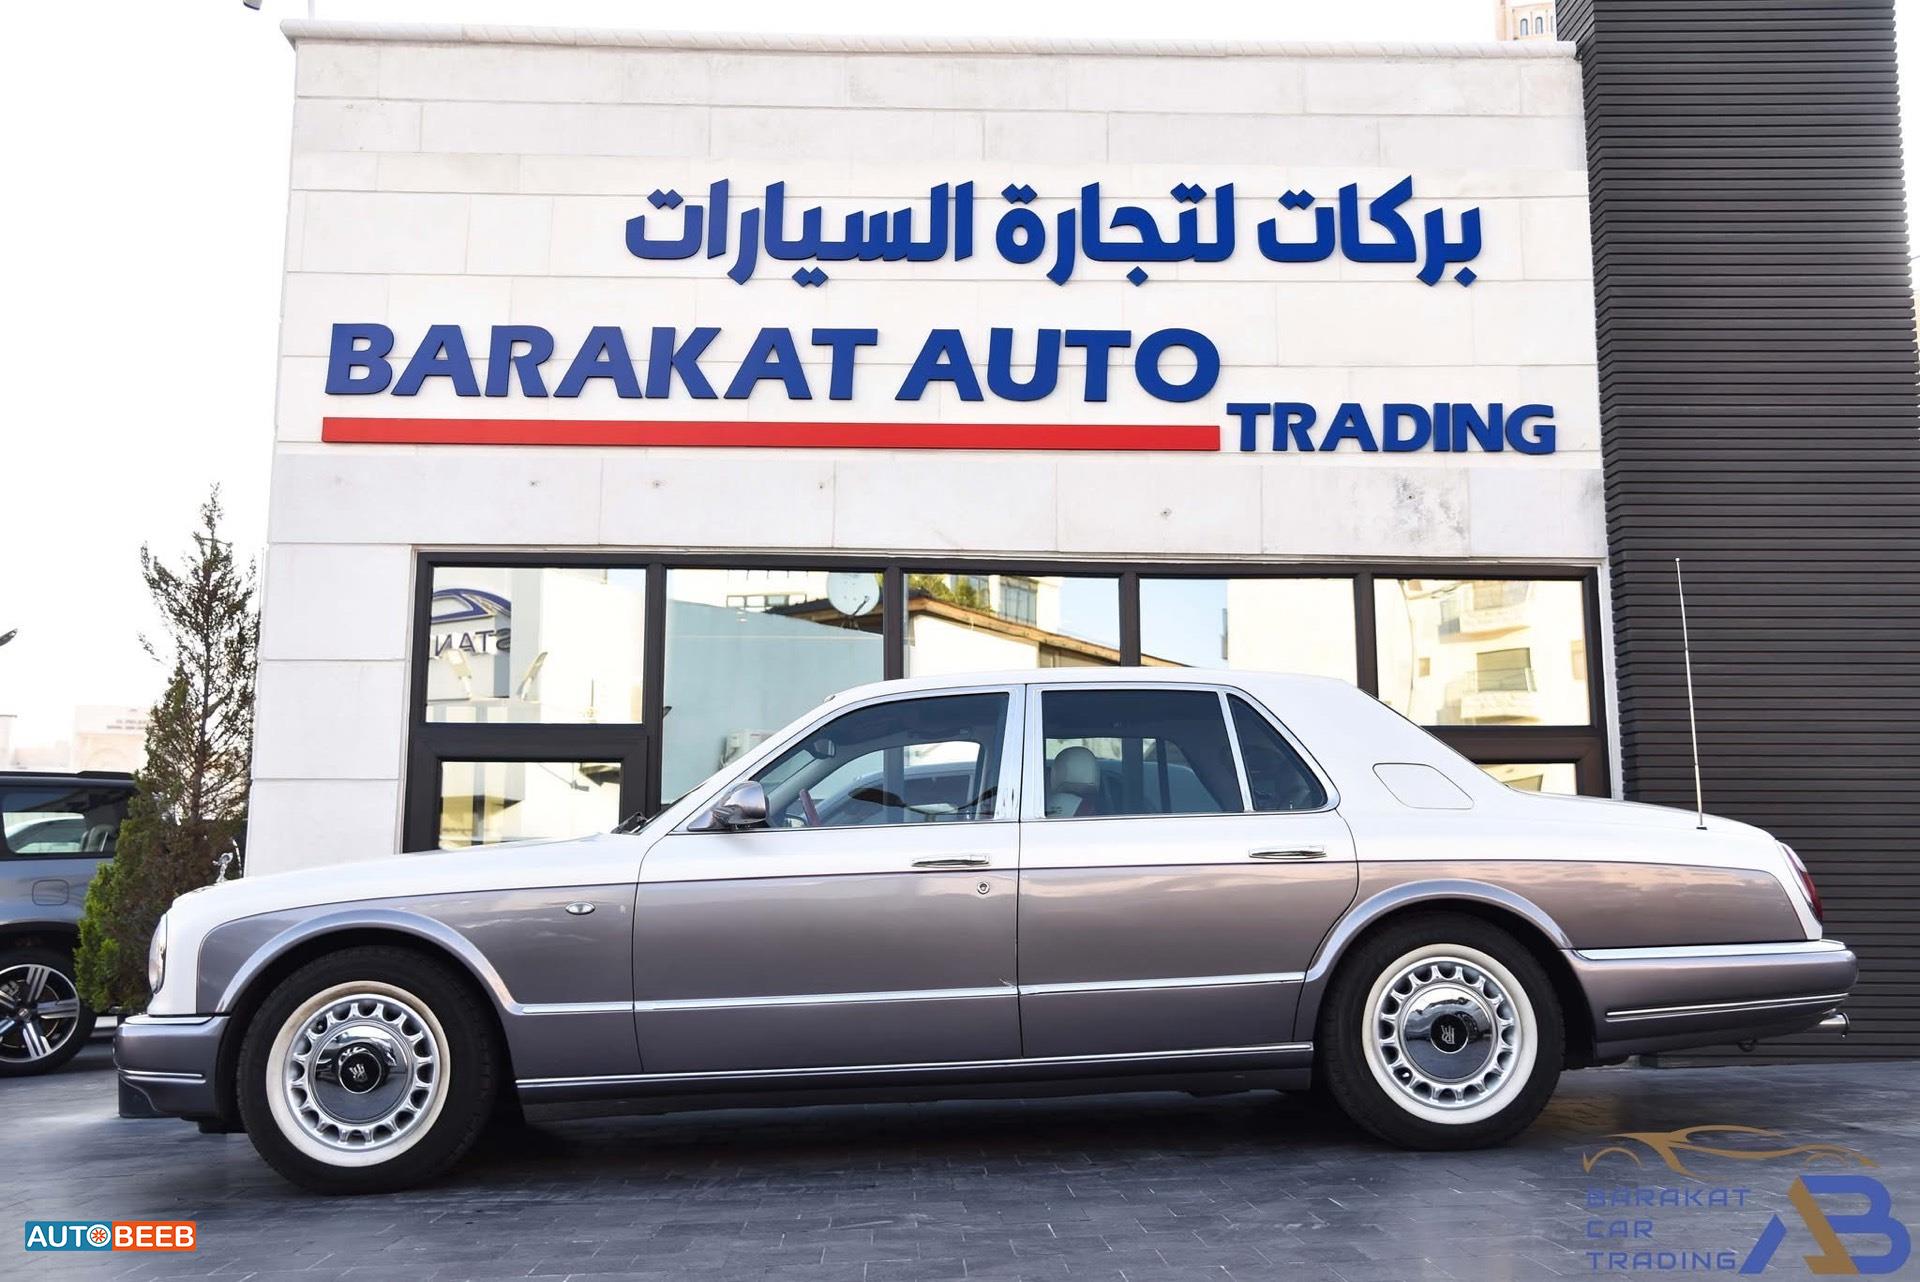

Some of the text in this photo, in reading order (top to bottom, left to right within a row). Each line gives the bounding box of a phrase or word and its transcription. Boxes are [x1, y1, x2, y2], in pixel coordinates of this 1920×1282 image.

[625, 174, 1482, 288] بركات لتجارة السيارات
[325, 323, 1221, 403] BARAKAT AUTO
[1226, 402, 1556, 455] TRADING
